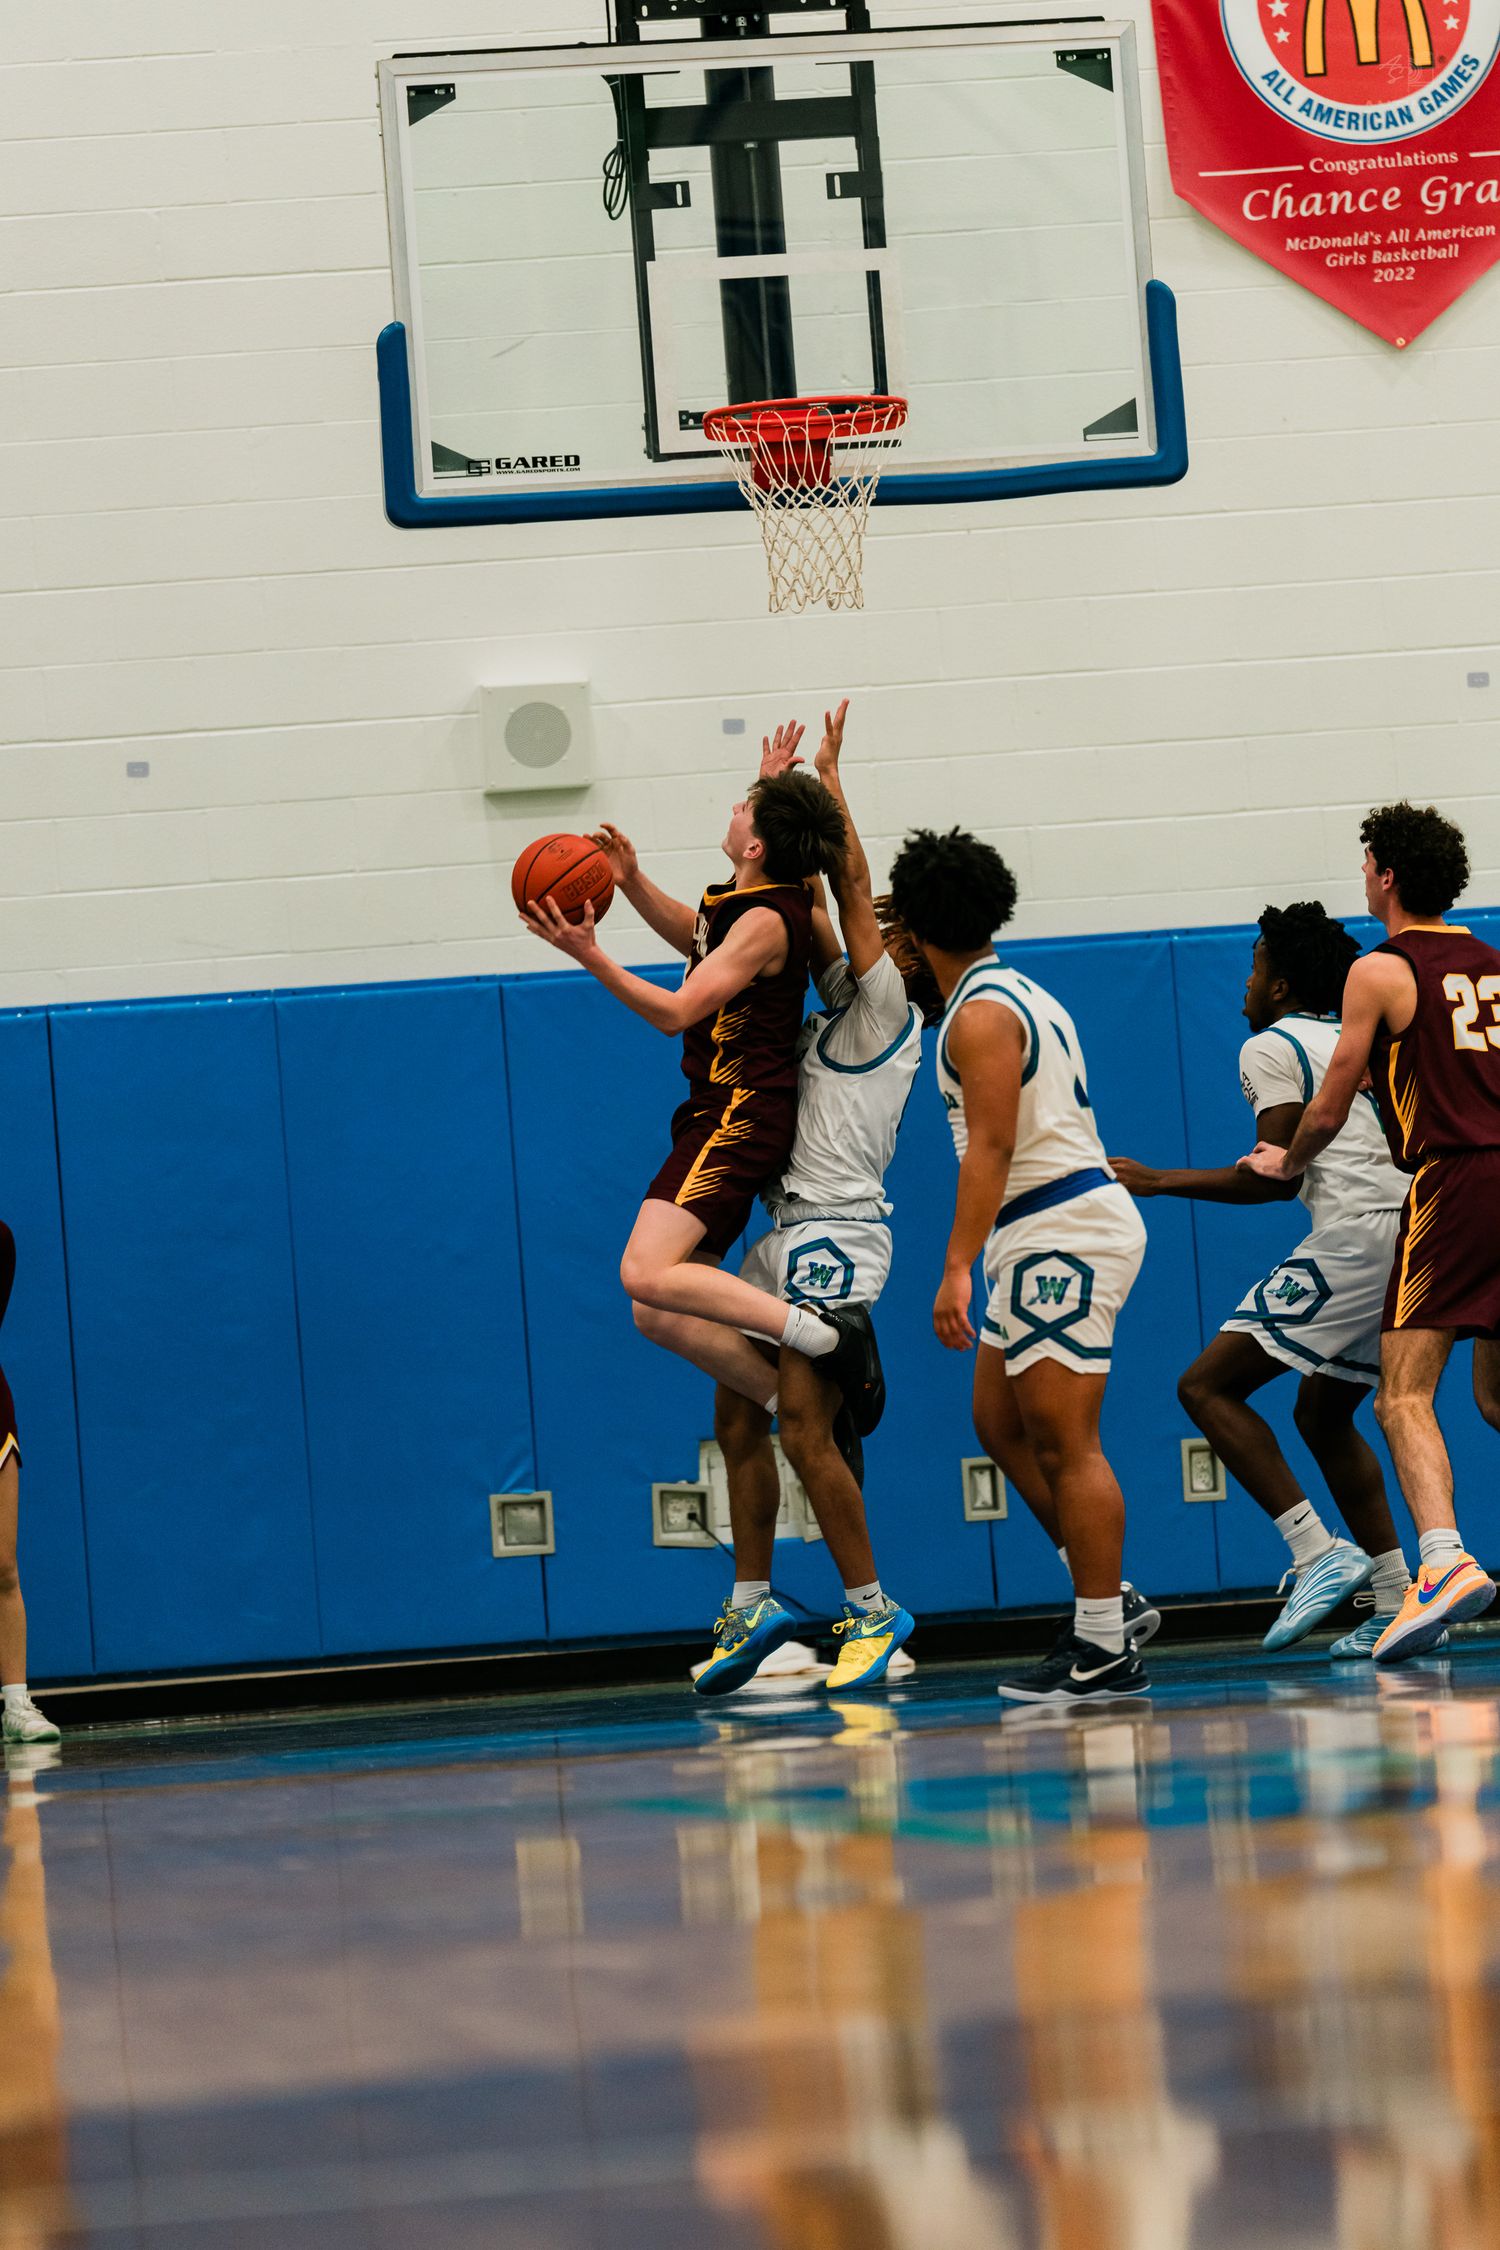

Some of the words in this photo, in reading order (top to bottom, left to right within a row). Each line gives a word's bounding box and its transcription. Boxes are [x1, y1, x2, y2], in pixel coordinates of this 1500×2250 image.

[1261, 69, 1293, 106] ALL
[1298, 99, 1415, 131] AMERICAN
[1418, 54, 1480, 116] GAMES
[1309, 151, 1459, 175] Congratulations
[1242, 183, 1401, 221] Chance
[1285, 230, 1382, 252] McDonald's
[1386, 228, 1411, 244] All
[1415, 224, 1497, 243] American
[1325, 251, 1367, 268] Girls
[1372, 244, 1460, 265] Basketball
[1373, 266, 1416, 283] 2022
[495, 455, 580, 469] GARED
[496, 467, 581, 475] WWW.GAREDSPORTS.COM
[1442, 973, 1500, 1052] 23
